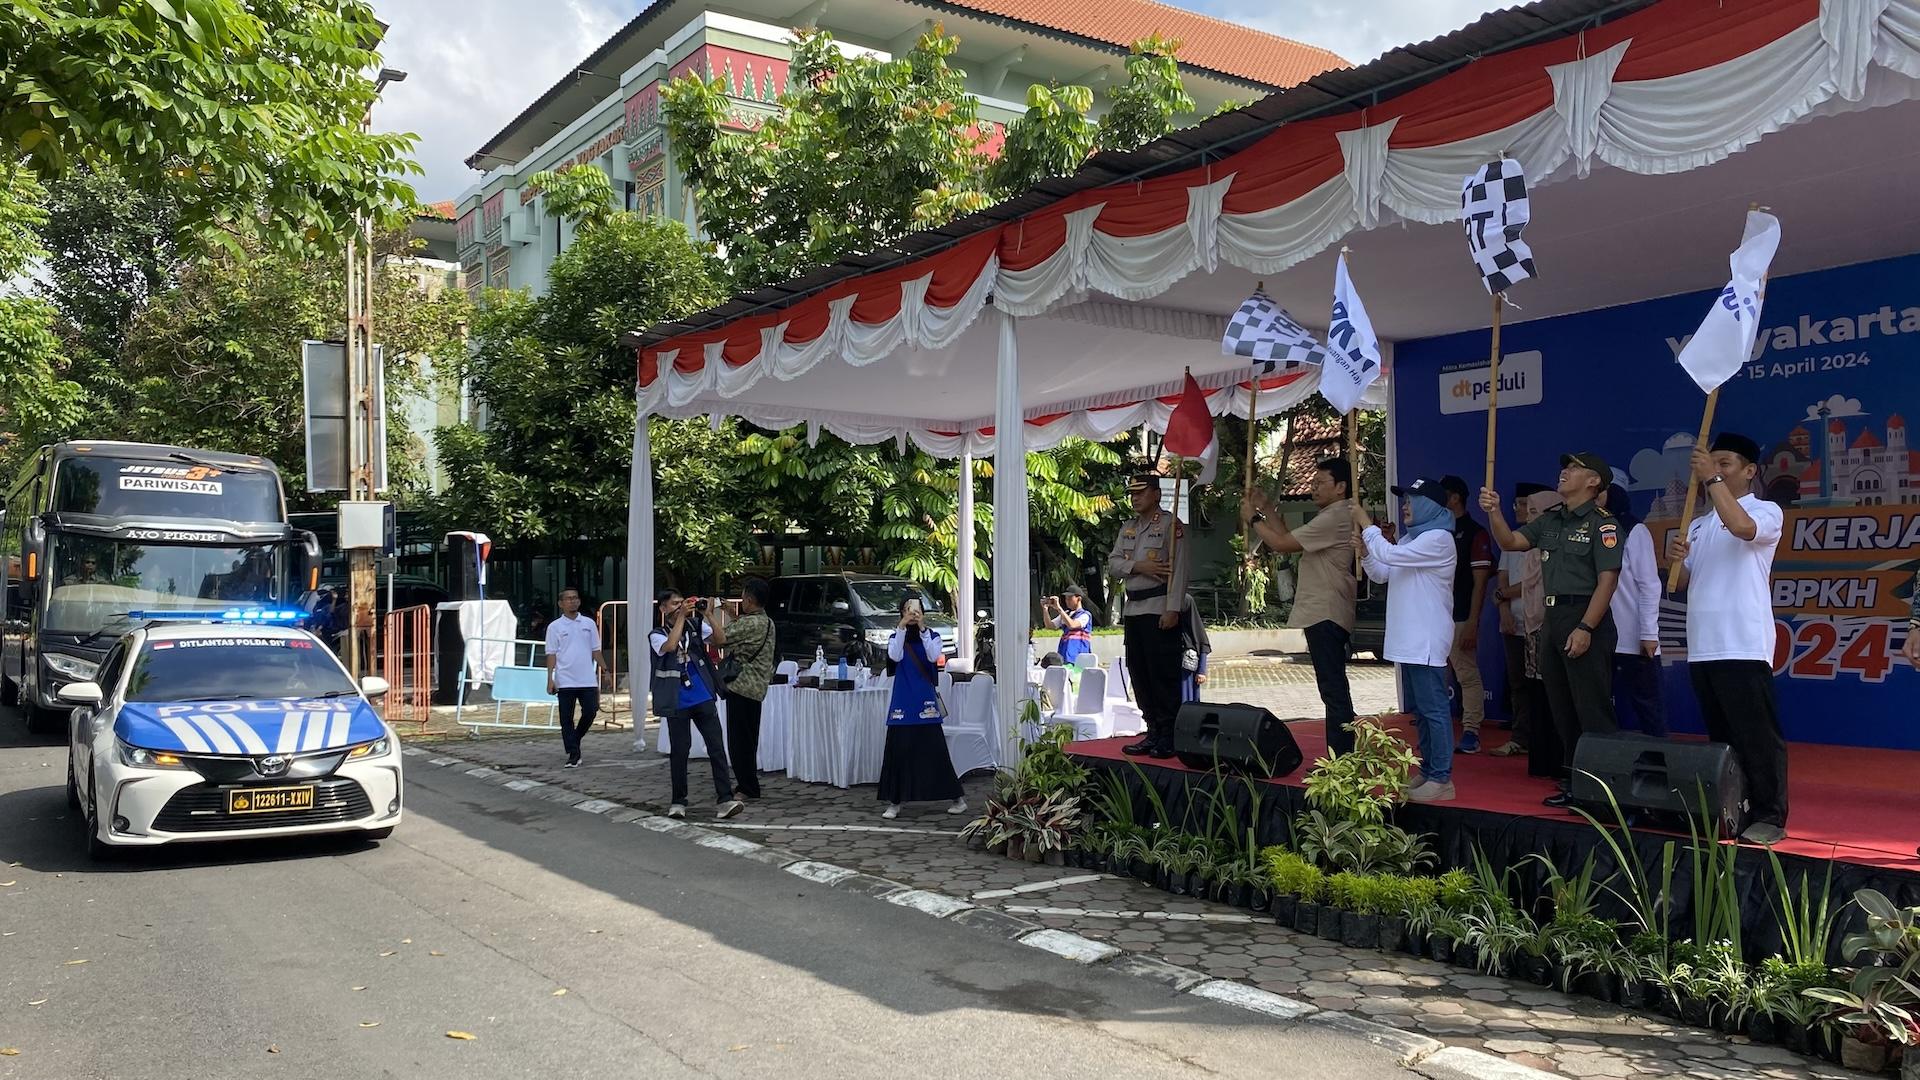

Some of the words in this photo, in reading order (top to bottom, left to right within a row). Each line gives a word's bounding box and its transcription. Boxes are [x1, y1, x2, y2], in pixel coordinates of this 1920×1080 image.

[1665, 304, 1920, 363] Yyakarta
[1749, 364, 1766, 379] 15
[1769, 356, 1816, 379] April
[1821, 351, 1872, 371] 2024
[124, 479, 219, 493] PARIWISATA
[126, 530, 160, 539] AYO
[162, 531, 218, 542] PIKNIK
[1792, 514, 1920, 550] KERJA
[1772, 577, 1878, 608] BPKH
[179, 639, 235, 648] DITLANTAS
[236, 639, 269, 647] POLDA
[159, 701, 348, 716] POLISI
[255, 790, 311, 808] 122611-XXIV
